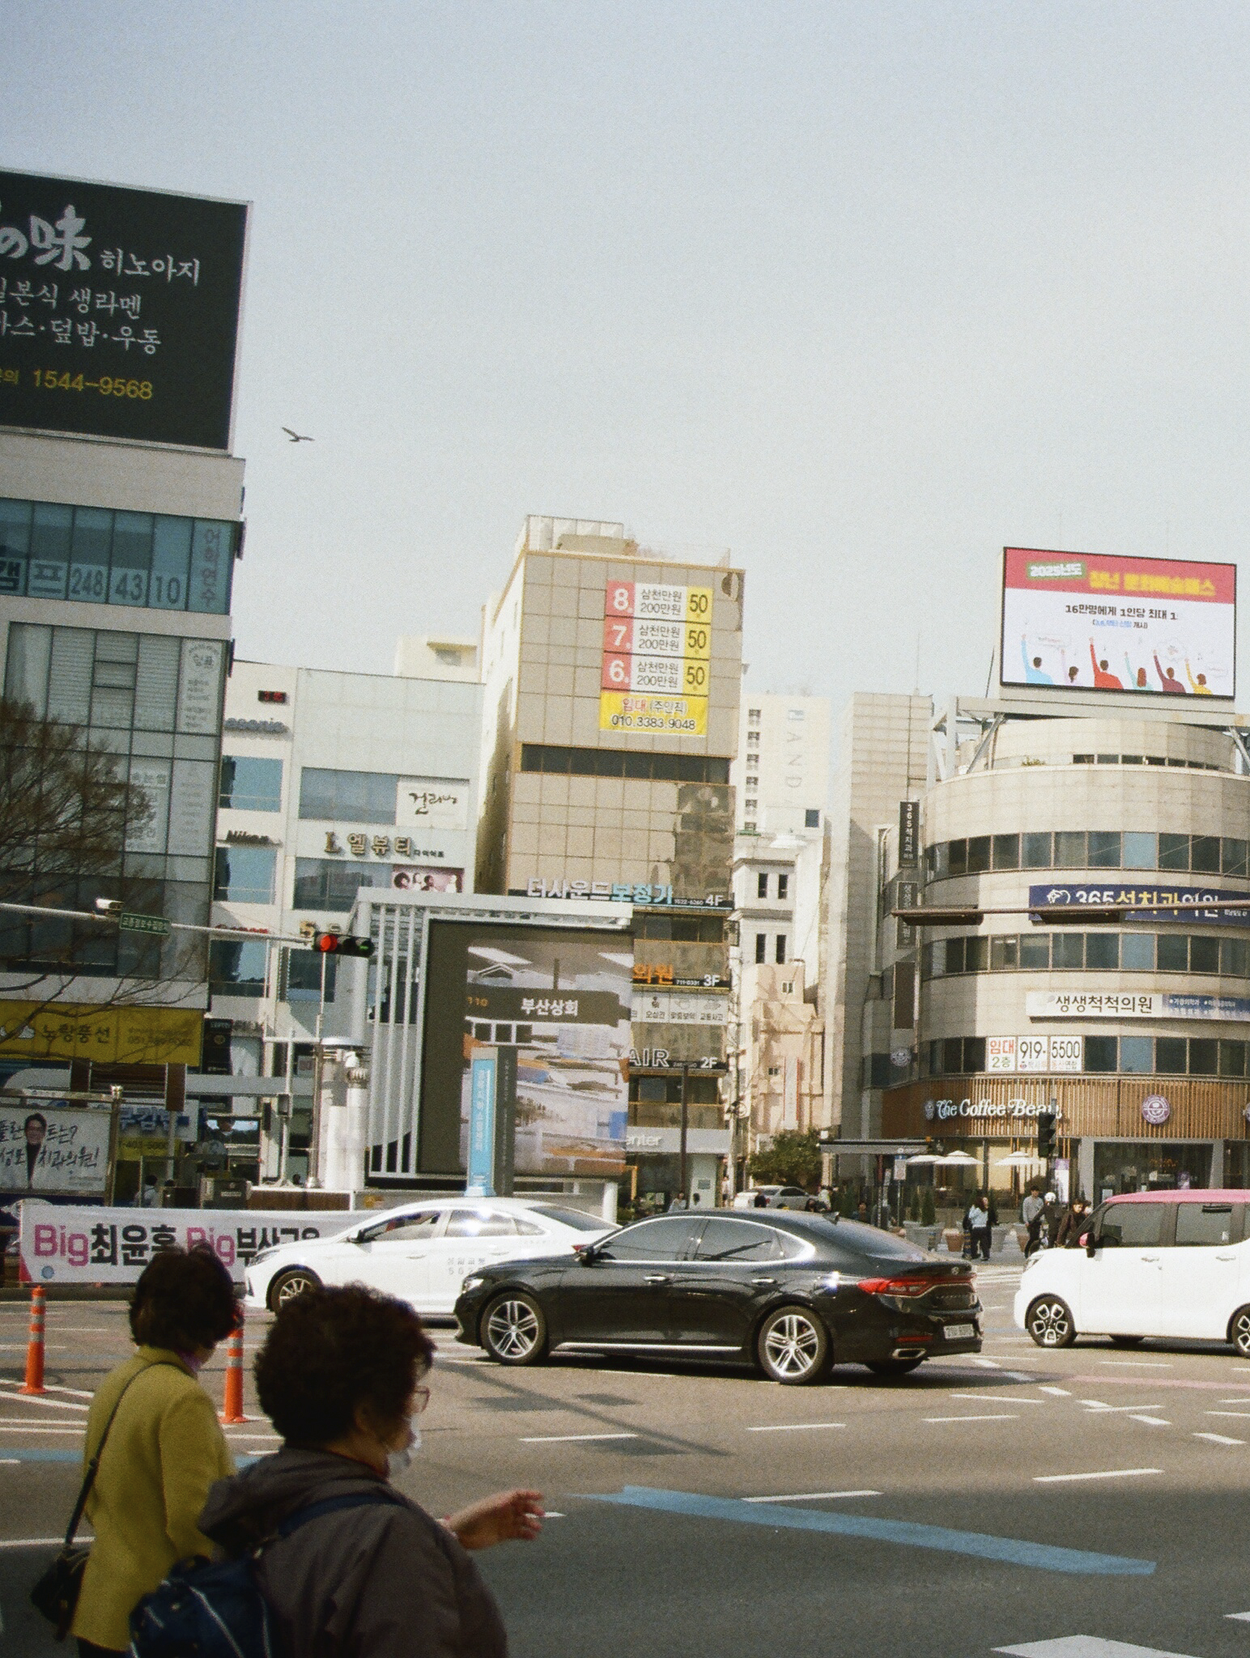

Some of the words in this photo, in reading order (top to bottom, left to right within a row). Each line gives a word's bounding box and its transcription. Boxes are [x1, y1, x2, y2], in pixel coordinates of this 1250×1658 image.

[100, 248, 201, 286] 히노아지
[70, 288, 142, 320] 생라멘
[34, 370, 153, 400] 1544-9568
[71, 567, 103, 596] 248
[115, 572, 143, 601] 43
[155, 575, 181, 604] 10
[641, 588, 682, 602] 삼천만원
[640, 602, 681, 615] 200만원
[689, 594, 708, 613] 50
[1065, 604, 1117, 616] 16만명에게
[1120, 608, 1146, 618] 1인당
[1148, 609, 1167, 619] 최대
[639, 624, 680, 639] 삼천만원
[638, 638, 680, 651] 200만원
[688, 630, 707, 649] 50
[637, 661, 679, 674] 삼천만원
[636, 674, 678, 688] 200만원
[687, 666, 705, 685] 50
[623, 697, 647, 712] 임대
[611, 714, 696, 731] 010.3383.9048
[226, 829, 270, 843] Nikon
[347, 832, 412, 858] 엘뷰티
[705, 895, 724, 906] 4F
[703, 974, 720, 987] 3F
[521, 998, 579, 1016] 부산상회
[1056, 995, 1153, 1014] 생생척척의원
[43, 1023, 111, 1044] 노랑풍선
[990, 1040, 1015, 1055] 임대
[701, 1056, 718, 1068] 2F
[991, 1057, 1012, 1068] 2층
[936, 1100, 958, 1119] The
[960, 1099, 1007, 1116] Coffee
